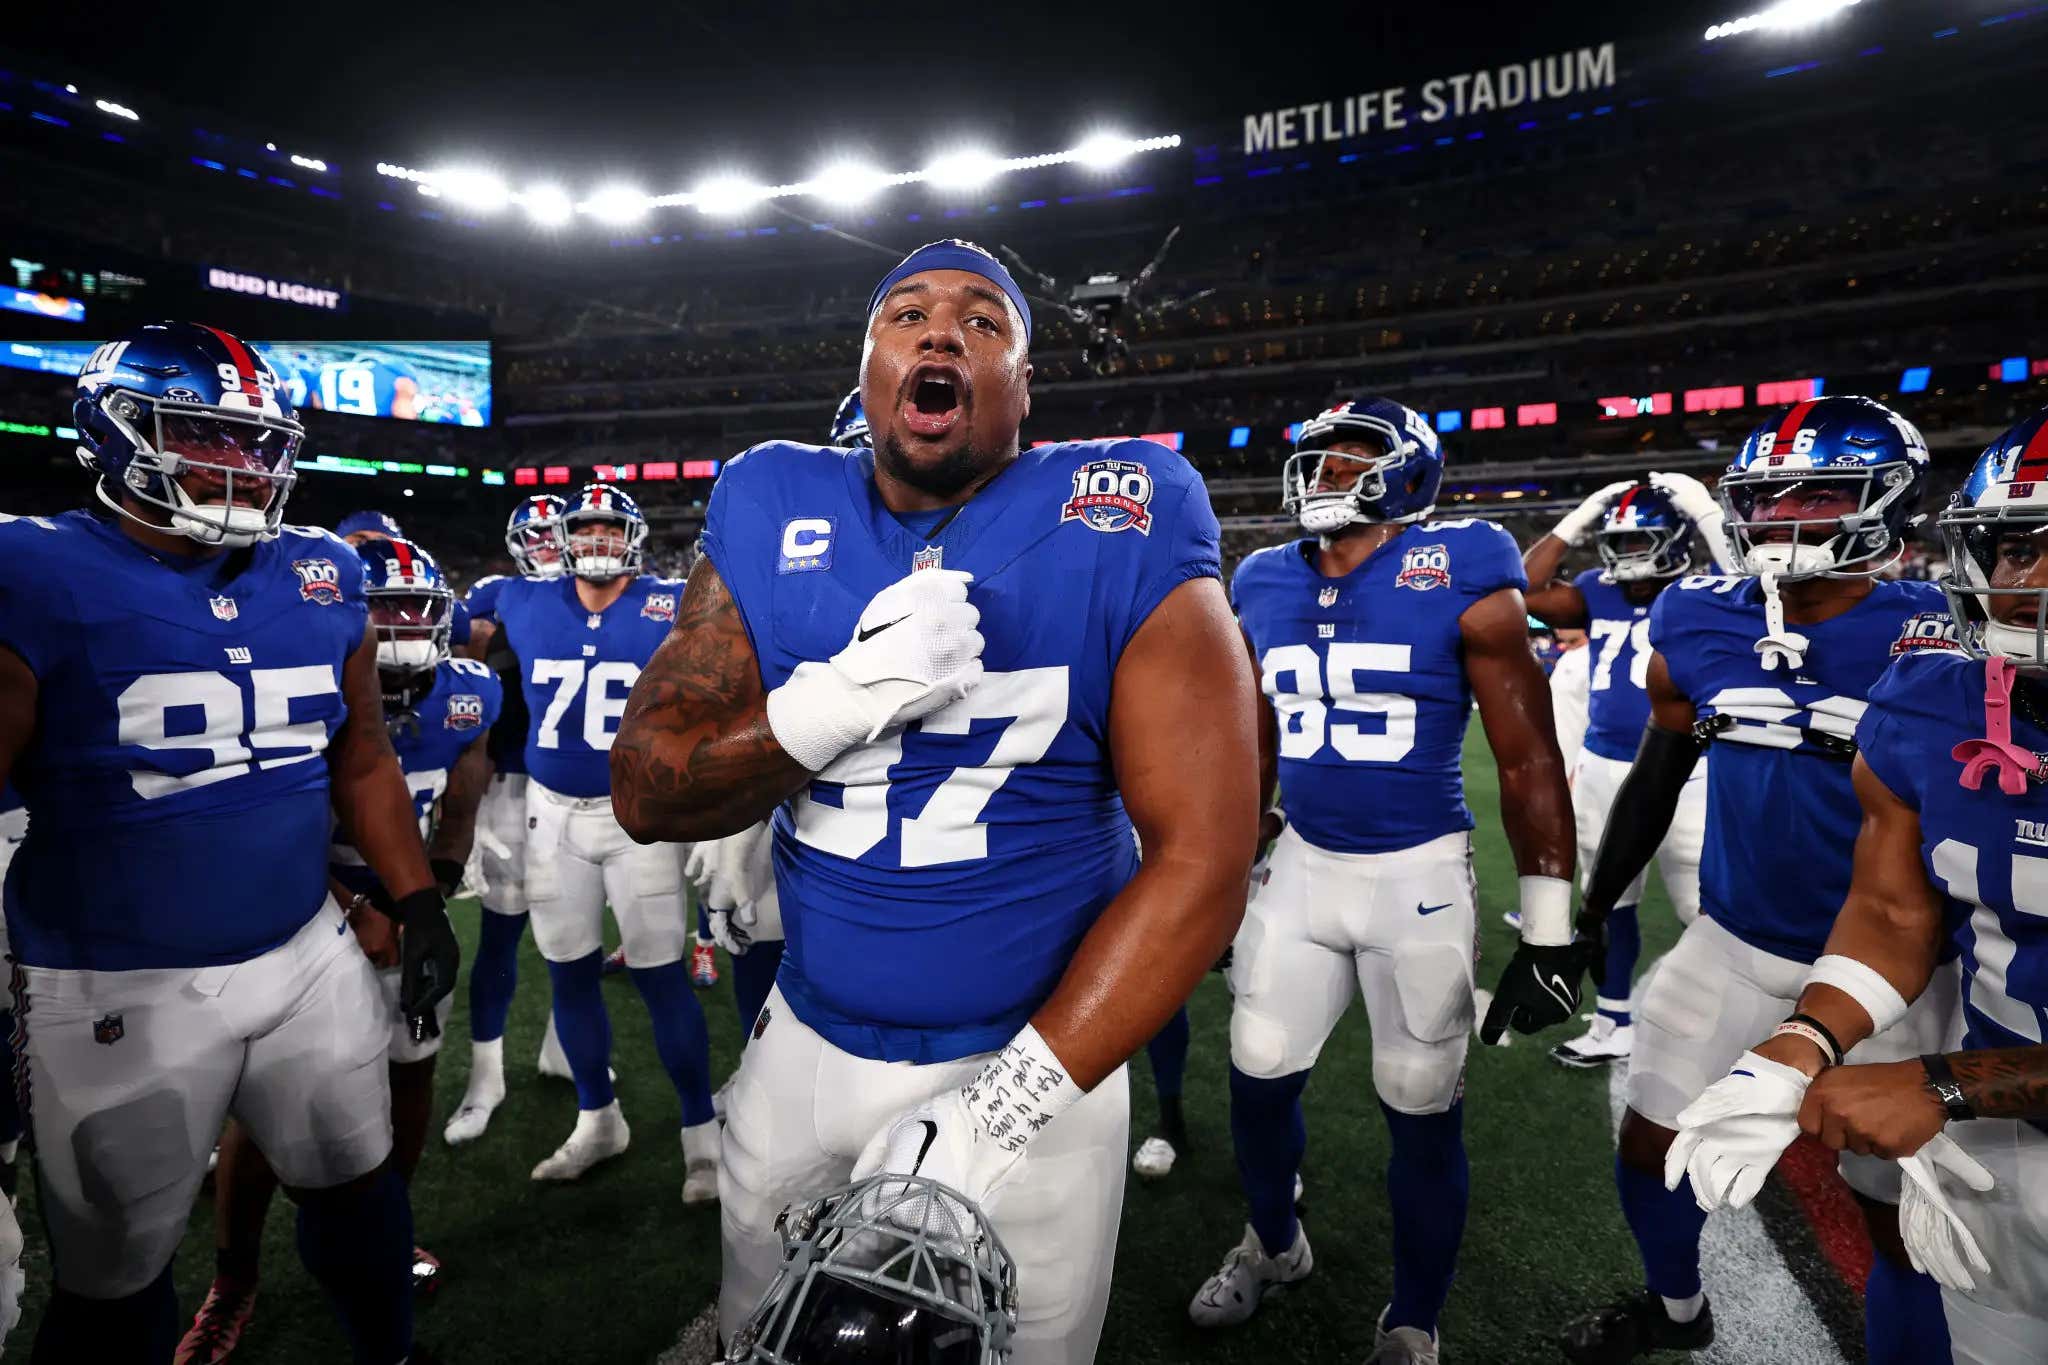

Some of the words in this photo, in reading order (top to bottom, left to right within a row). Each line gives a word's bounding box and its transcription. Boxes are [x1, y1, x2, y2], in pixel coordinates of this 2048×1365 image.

[1243, 86, 1408, 155] METLIFE
[1420, 42, 1617, 124] STADIUM
[208, 267, 266, 298] BUD
[265, 279, 342, 310] LIGHT
[319, 361, 378, 417] 19
[1074, 470, 1150, 503] 100
[1078, 496, 1140, 513] SEASONS
[782, 518, 832, 559] C
[297, 566, 339, 584] 100
[1404, 551, 1448, 571] 100
[1261, 642, 1417, 763] 85
[117, 664, 340, 800] 95
